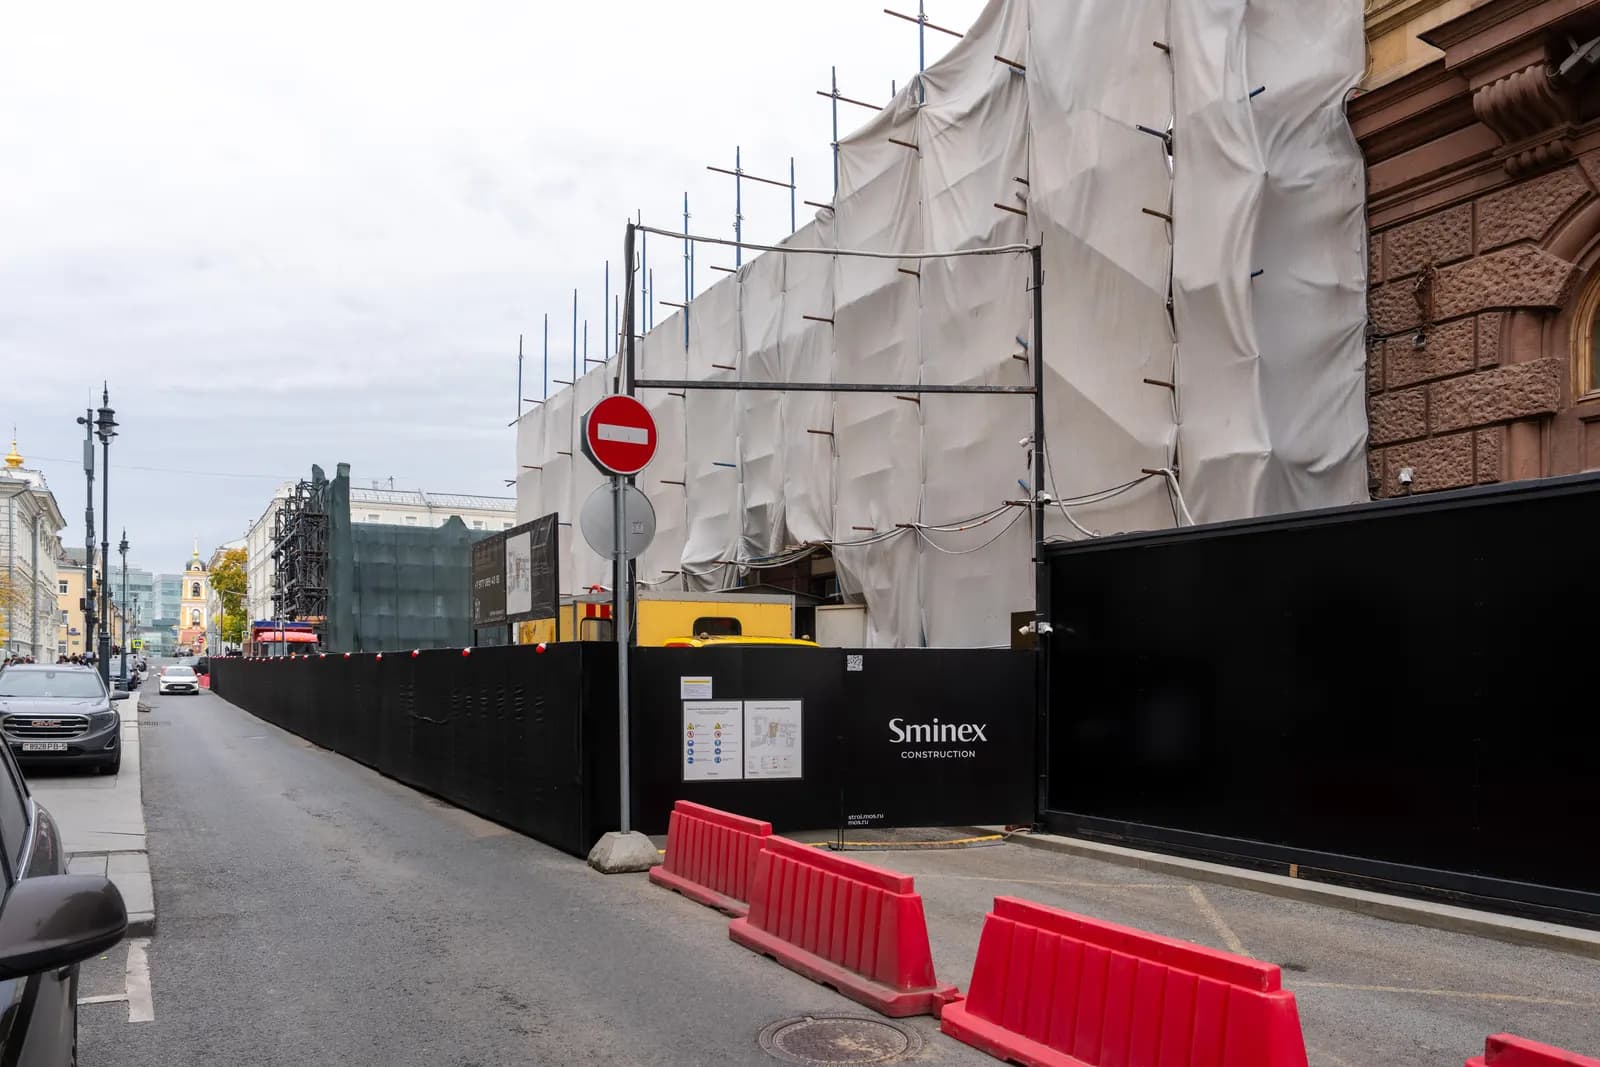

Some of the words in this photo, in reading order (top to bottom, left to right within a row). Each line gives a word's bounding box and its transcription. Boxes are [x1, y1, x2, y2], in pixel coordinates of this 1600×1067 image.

[32, 720, 62, 728] GMC
[888, 718, 988, 743] Sminex
[901, 750, 976, 759] CONSTRUCTION
